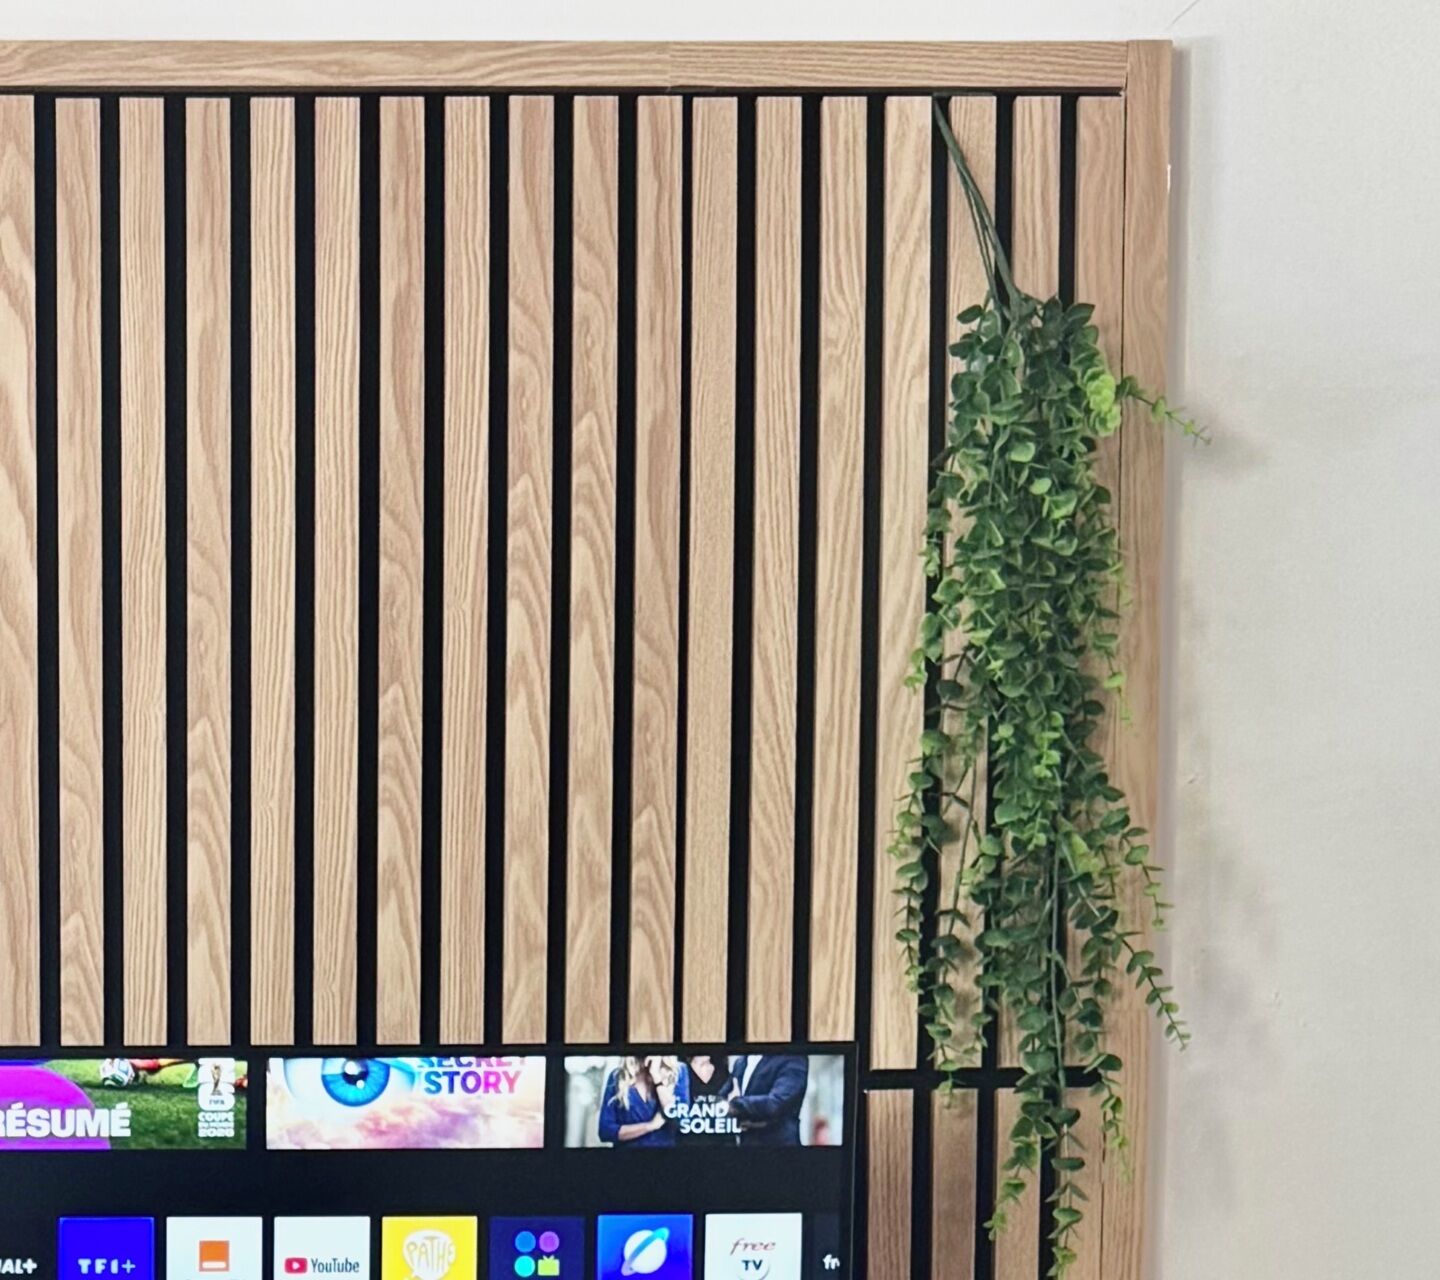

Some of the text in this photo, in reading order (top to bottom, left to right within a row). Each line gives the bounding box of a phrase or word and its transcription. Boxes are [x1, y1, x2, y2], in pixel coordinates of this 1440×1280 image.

[424, 1070, 521, 1094] STORY
[664, 1101, 729, 1119] GRAND
[680, 1118, 742, 1134] SOLEIL
[731, 1238, 776, 1255] free
[77, 1259, 136, 1274] TF1+
[311, 1257, 360, 1273] YouTube
[742, 1260, 763, 1270] TV
